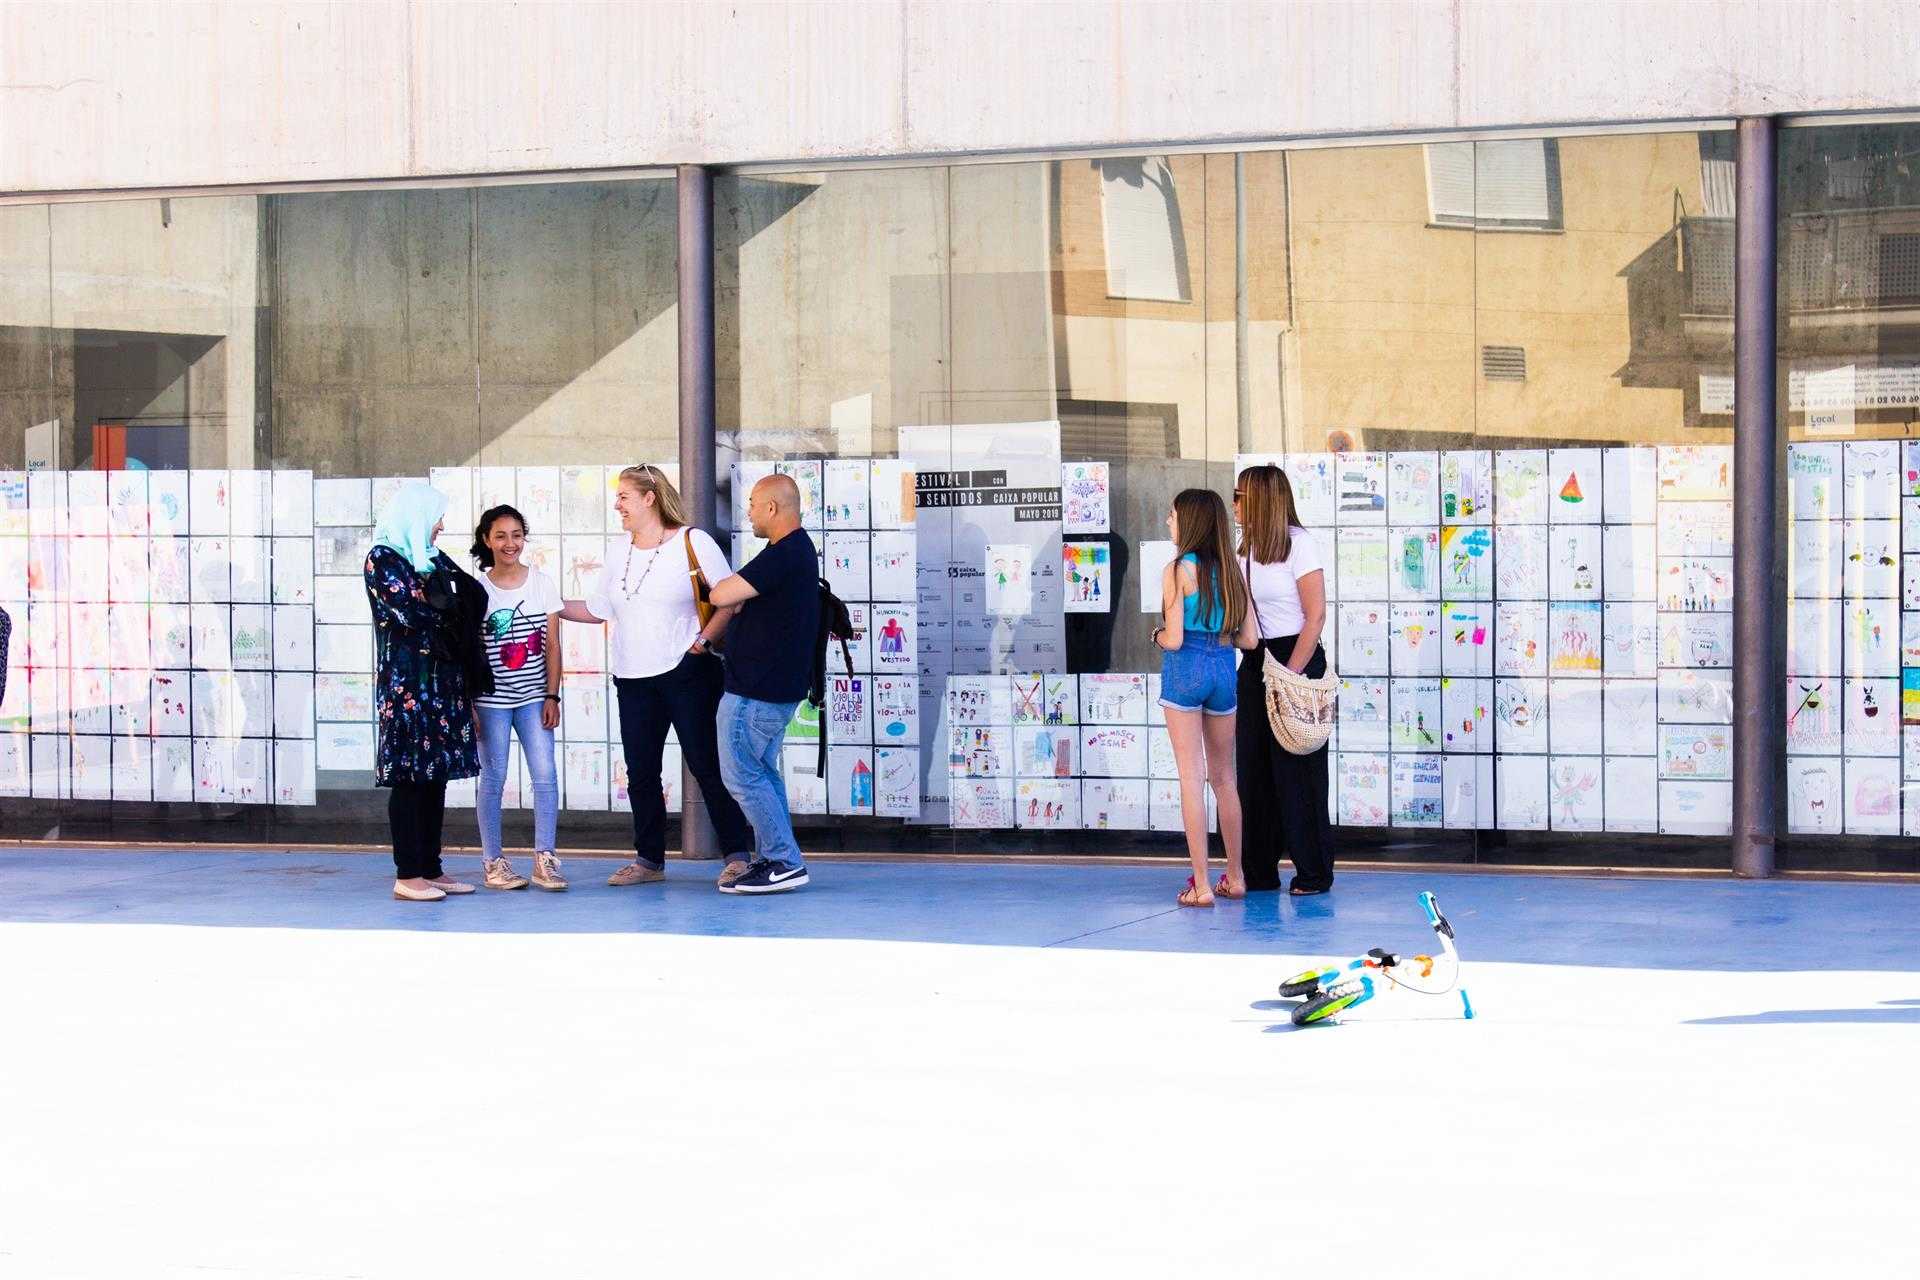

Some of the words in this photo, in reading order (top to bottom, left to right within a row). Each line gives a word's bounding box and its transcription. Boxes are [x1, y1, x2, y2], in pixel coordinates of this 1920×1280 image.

[1811, 414, 1836, 423] Local
[926, 491, 982, 506] SENTIDOS
[993, 493, 1019, 504] CAIXA
[1021, 491, 1058, 503] POPULAR
[1019, 509, 1040, 519] MAYO
[1042, 508, 1059, 518] 2019
[835, 680, 862, 692] NO
